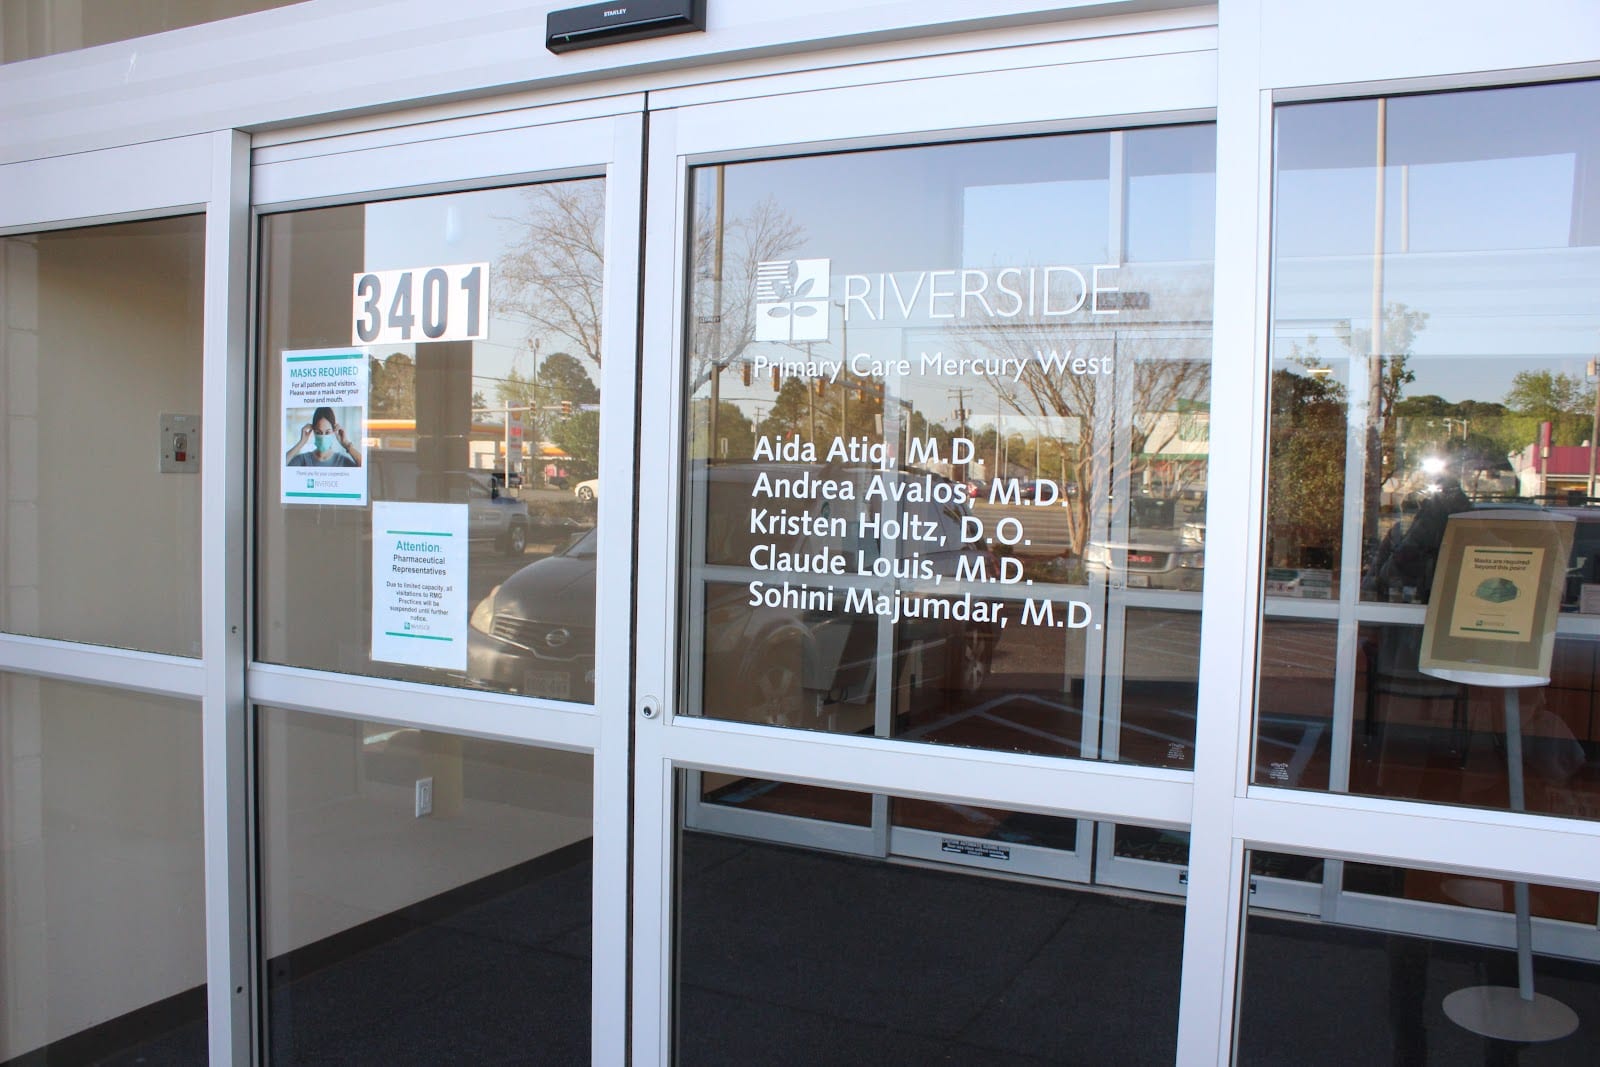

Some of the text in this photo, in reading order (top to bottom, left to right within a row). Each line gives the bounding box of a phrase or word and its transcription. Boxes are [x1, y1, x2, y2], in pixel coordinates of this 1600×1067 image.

[603, 8, 627, 17] STANLEY
[844, 264, 1121, 321] RIVERSIDE
[356, 266, 481, 342] 3401
[290, 366, 358, 378] MASKS REQUIRED
[754, 350, 1112, 384] Primary Care Mercury West
[306, 381, 326, 389] patients
[347, 388, 359, 396] your
[326, 396, 344, 404] mouth.
[752, 435, 985, 471] Aida Atiq, M.D.
[751, 471, 1068, 510] Andrea Avalos, M.D.
[750, 508, 1032, 547] Kristen Holtz, D.O.
[393, 554, 446, 565] Pharmaceutical
[749, 544, 1034, 586] Claude Louis, M.D.
[392, 564, 447, 576] Representatives
[398, 597, 422, 605] Practices
[749, 581, 1102, 631] Sohini Majumdar, M.D.
[430, 608, 448, 616] further
